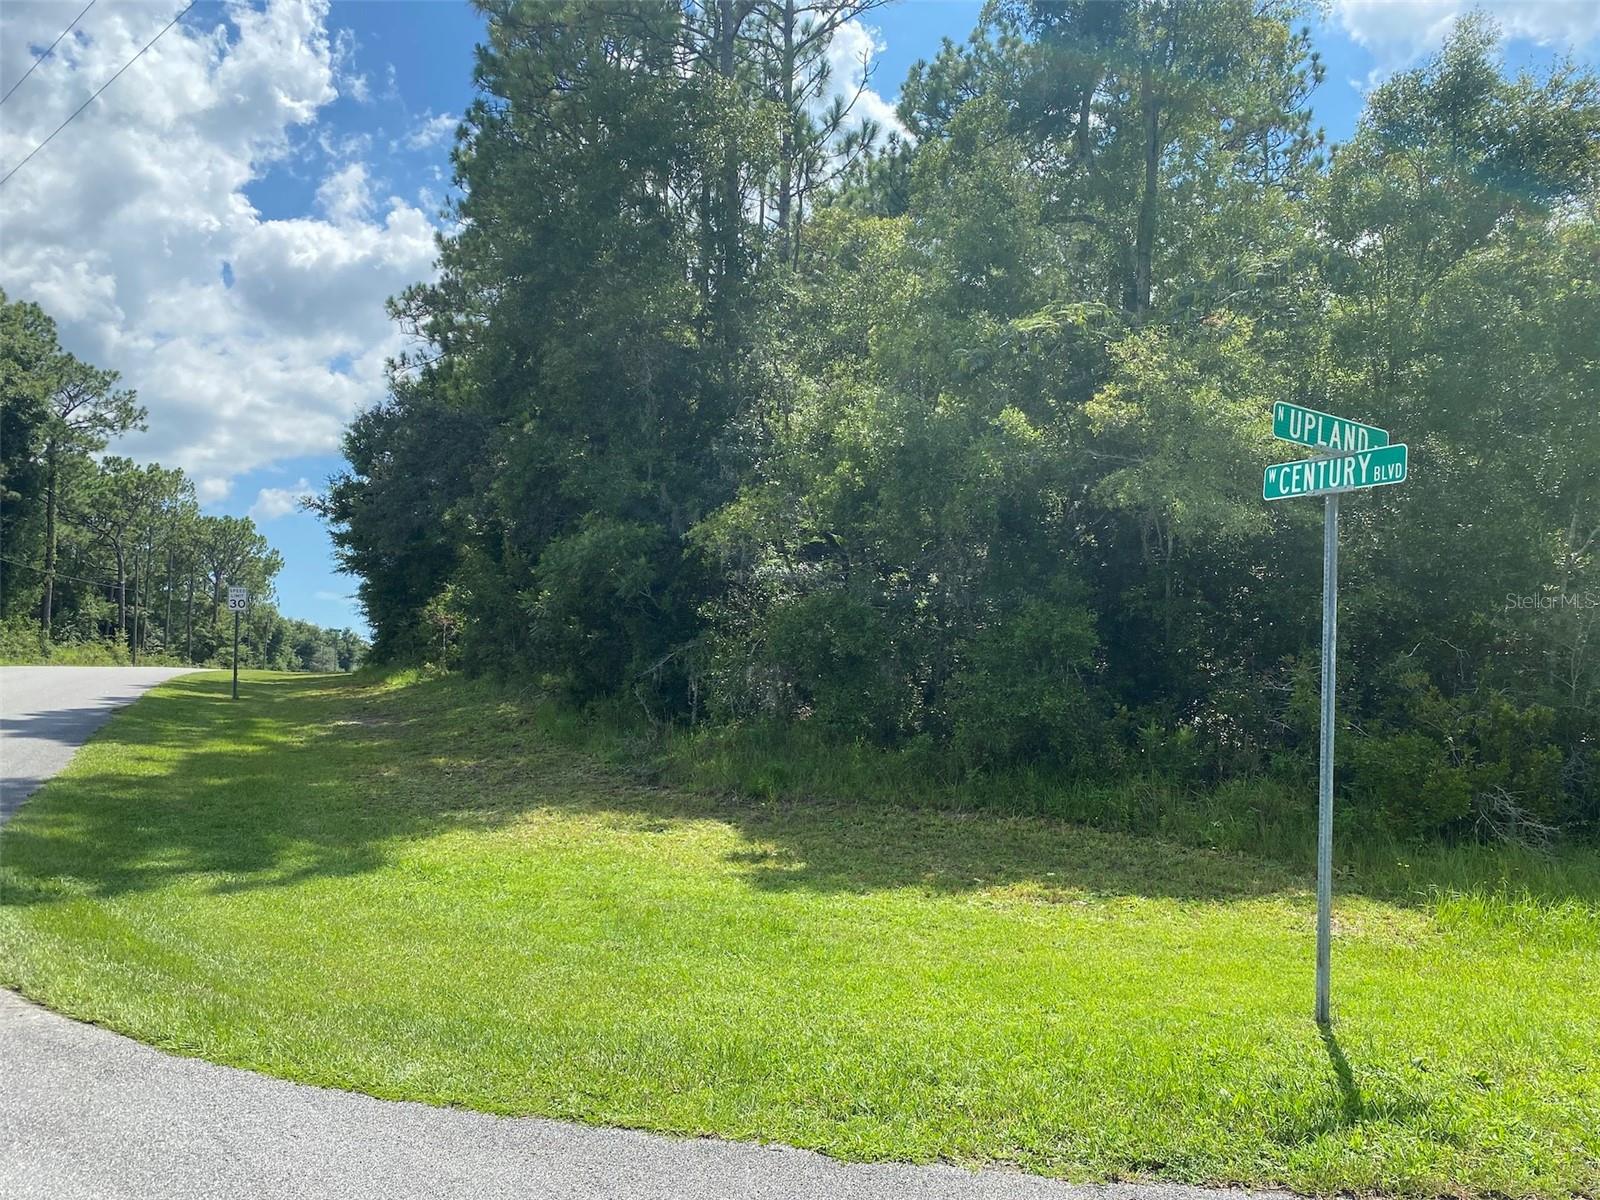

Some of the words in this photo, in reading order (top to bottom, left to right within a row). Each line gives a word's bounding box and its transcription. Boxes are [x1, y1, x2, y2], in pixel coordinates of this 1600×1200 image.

[1277, 405, 1285, 422] N
[1289, 409, 1369, 452] UPLAND
[1268, 468, 1277, 483] W
[1279, 453, 1371, 494] CENTURY
[1373, 462, 1402, 481] BLVD
[229, 599, 246, 608] 30
